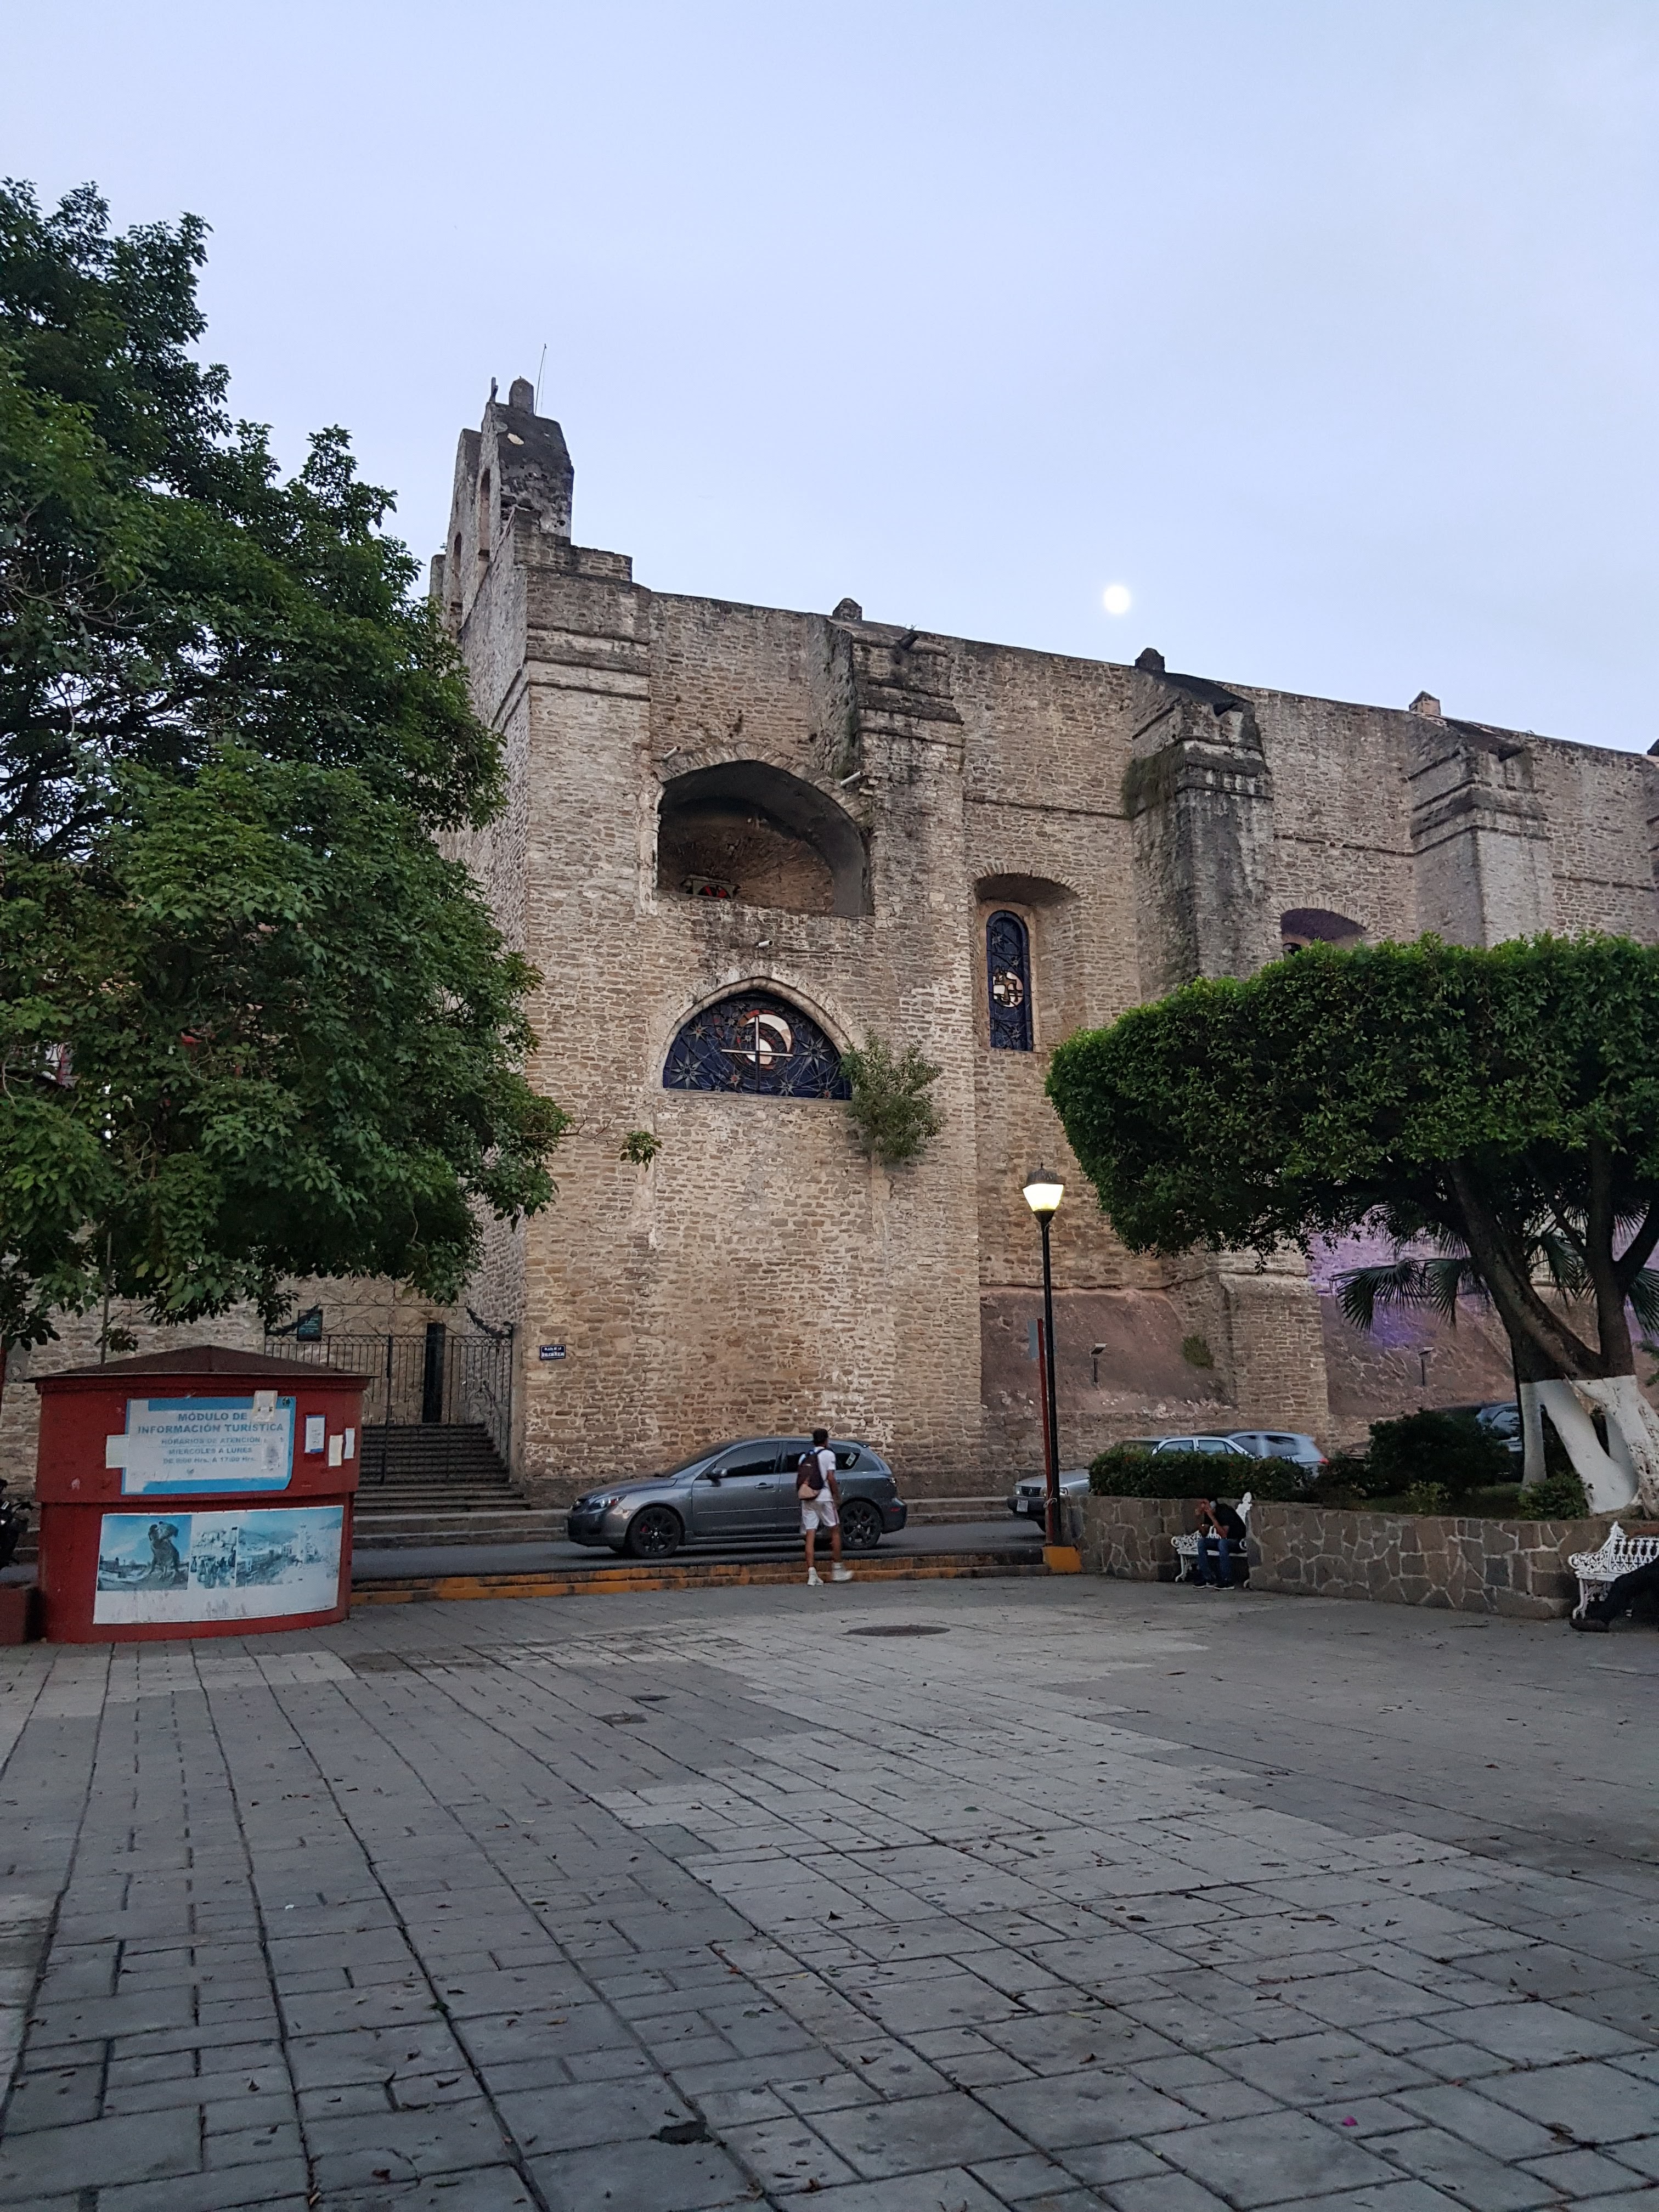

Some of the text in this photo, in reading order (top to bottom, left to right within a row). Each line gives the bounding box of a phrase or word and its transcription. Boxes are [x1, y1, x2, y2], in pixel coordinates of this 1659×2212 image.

[178, 1412, 247, 1421] MÓDULO DE
[138, 1422, 283, 1434] INFORMACIÓN TURÍSTICA
